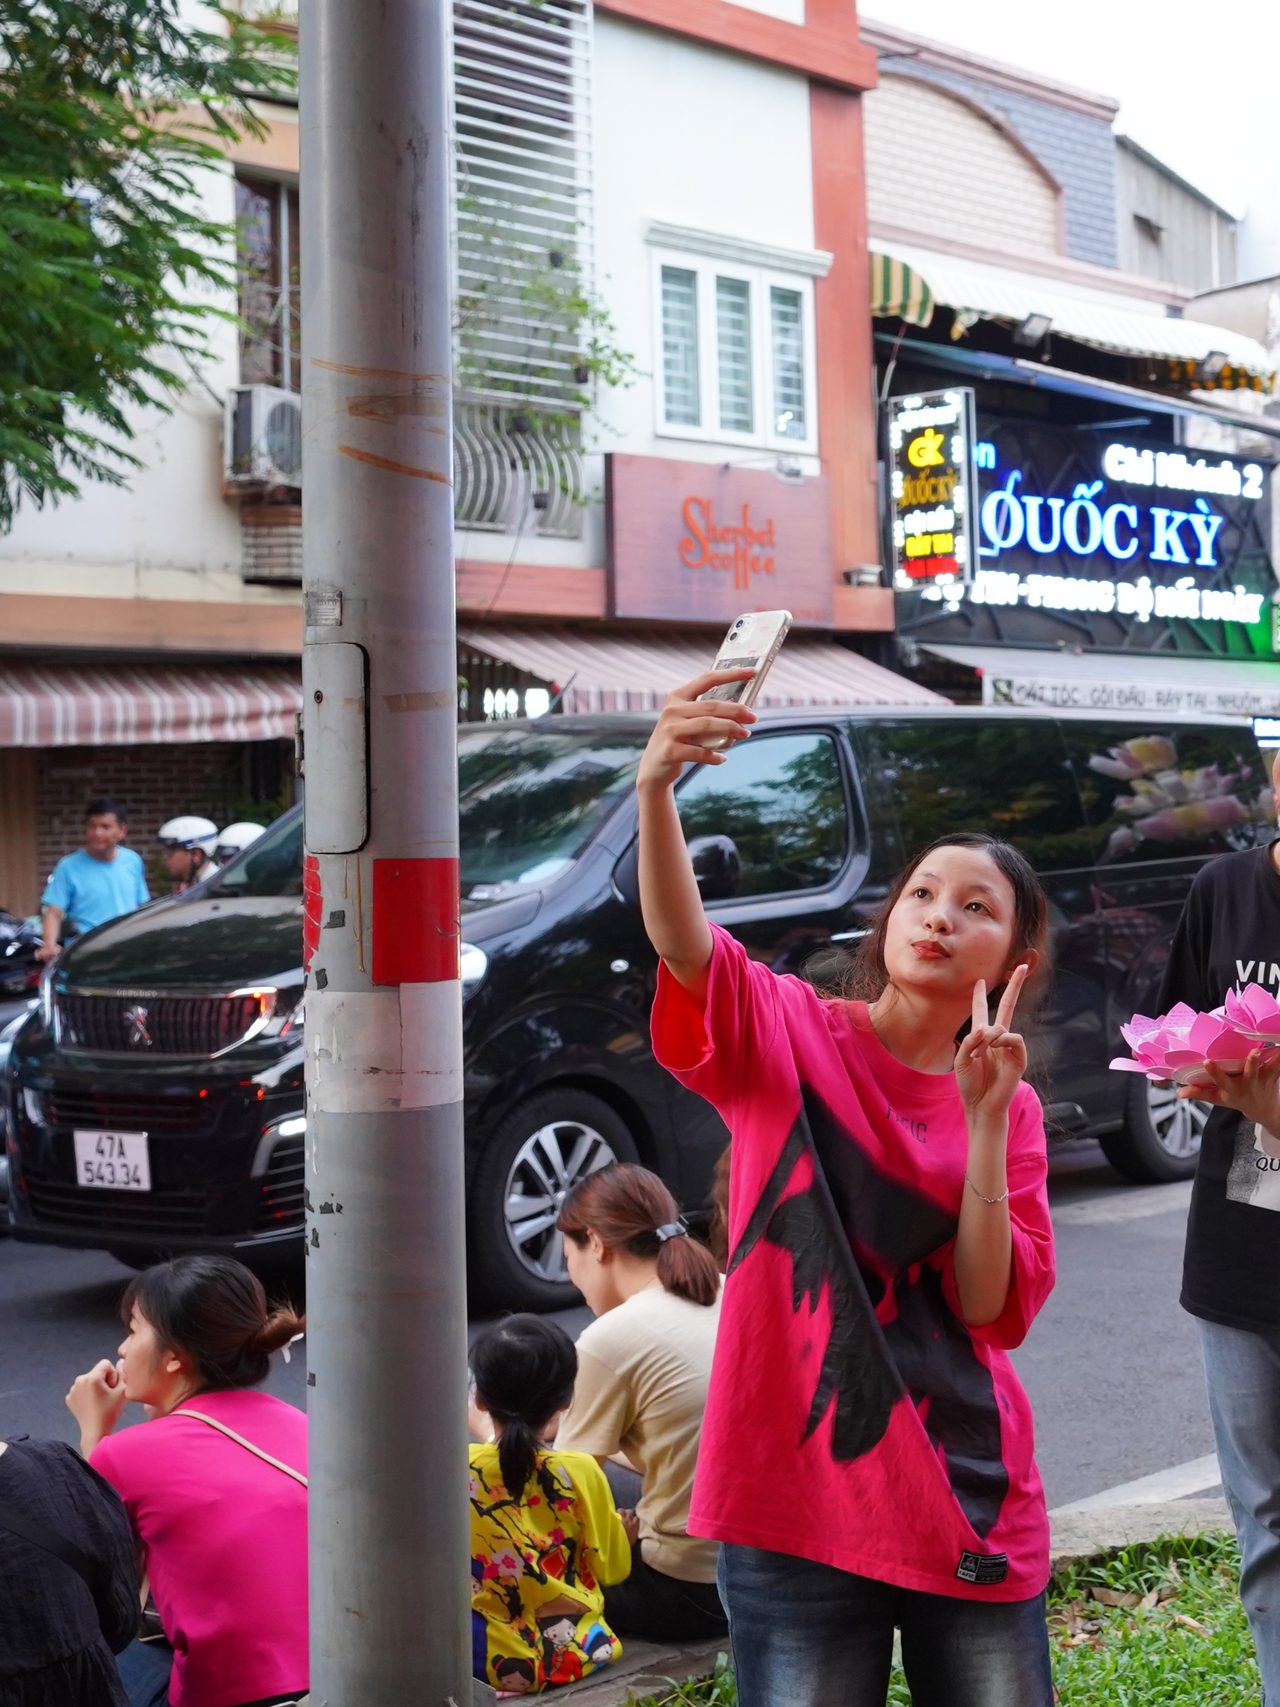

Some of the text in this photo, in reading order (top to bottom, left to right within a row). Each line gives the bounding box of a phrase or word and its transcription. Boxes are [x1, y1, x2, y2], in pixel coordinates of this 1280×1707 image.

[1242, 463, 1263, 499] 2
[678, 496, 776, 568] Sherbet
[1150, 498, 1223, 567] KỲ
[709, 547, 776, 589] coffee
[95, 1136, 127, 1159] 47A
[83, 1160, 141, 1187] 543.34
